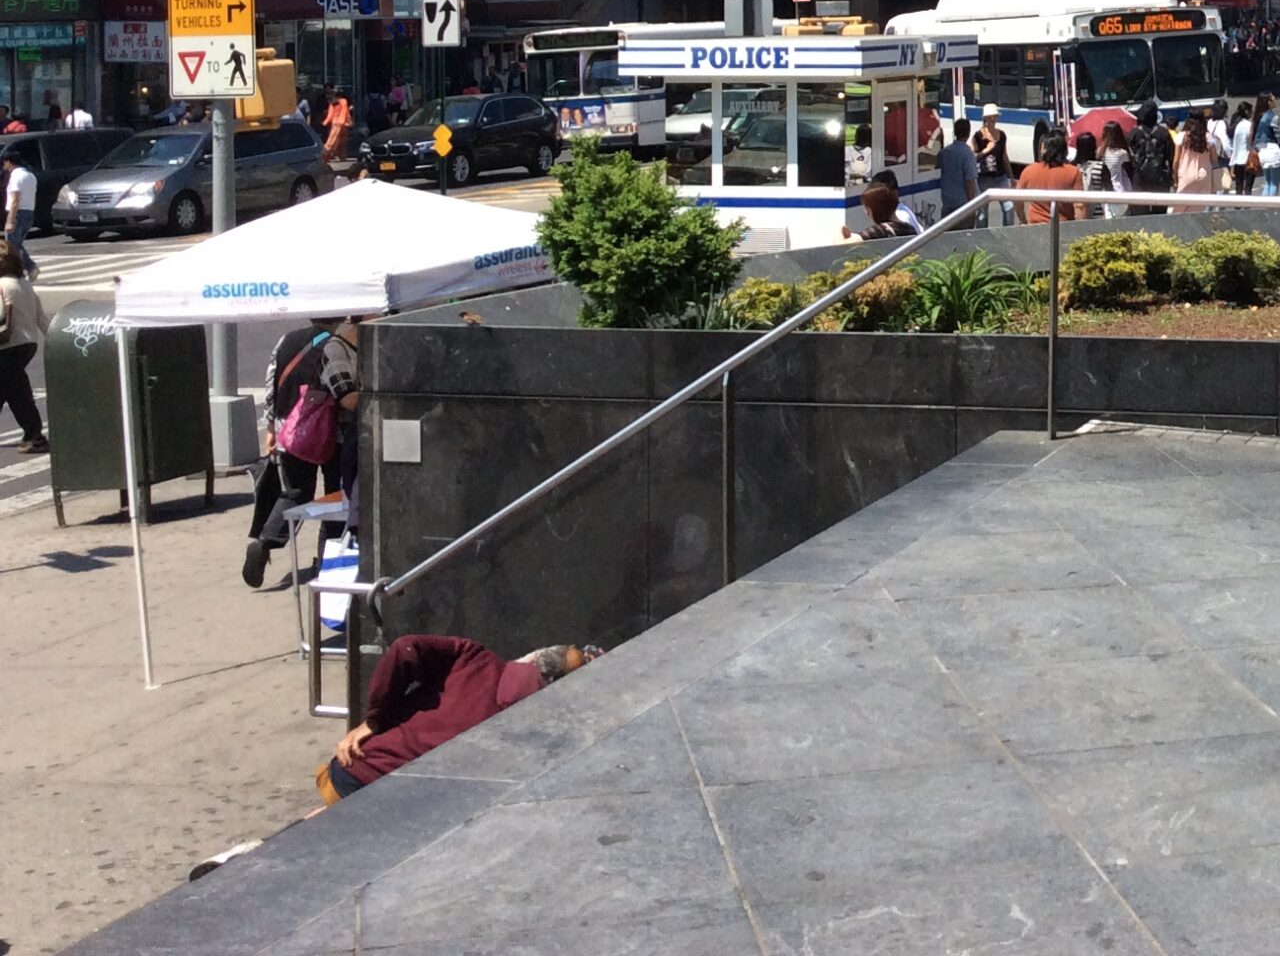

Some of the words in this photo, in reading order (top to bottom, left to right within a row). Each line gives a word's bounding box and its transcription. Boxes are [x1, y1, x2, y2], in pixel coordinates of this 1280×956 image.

[176, 15, 222, 29] VEHICLES
[1098, 17, 1123, 36] Q65
[691, 47, 790, 69] POLICE
[899, 42, 946, 66] NYD
[206, 60, 220, 73] TO
[202, 281, 290, 299] assurance
